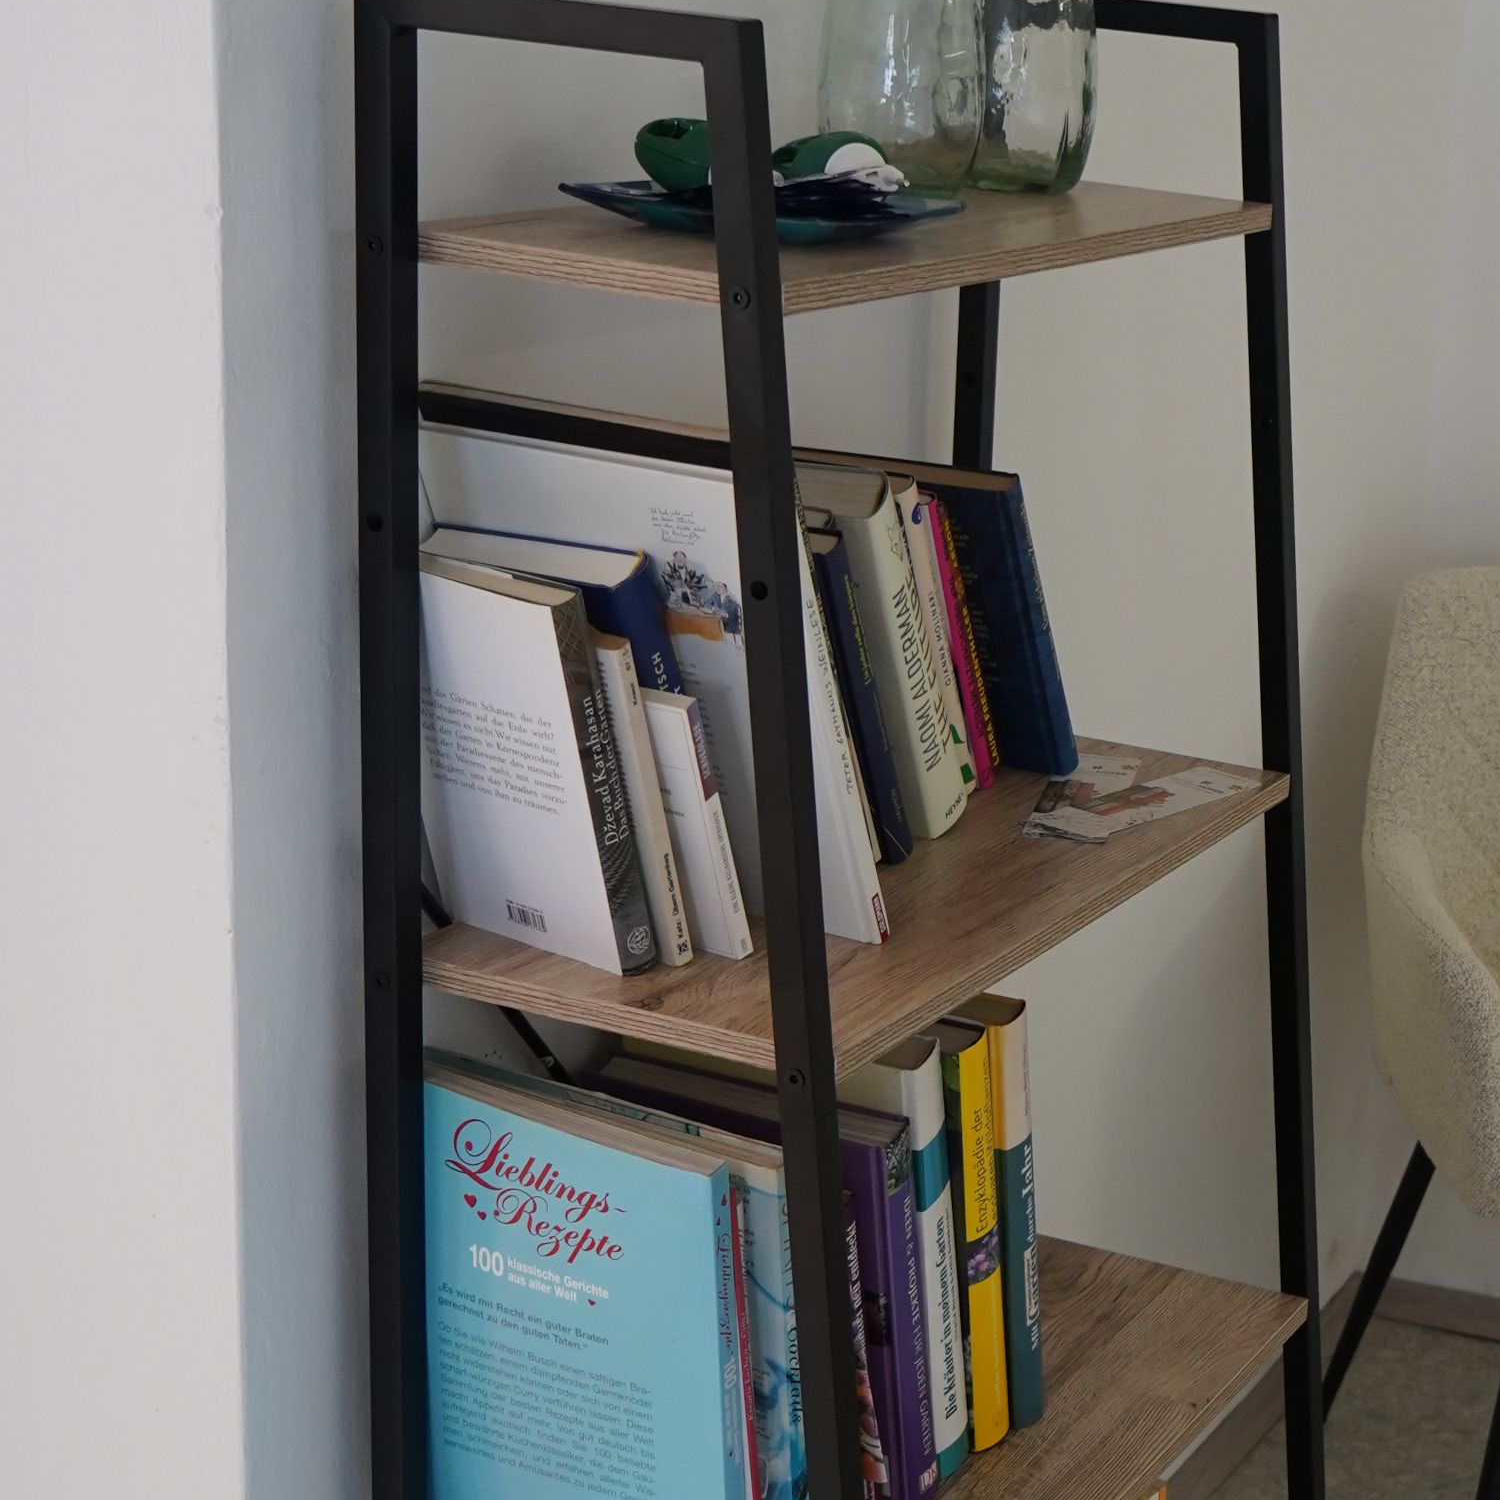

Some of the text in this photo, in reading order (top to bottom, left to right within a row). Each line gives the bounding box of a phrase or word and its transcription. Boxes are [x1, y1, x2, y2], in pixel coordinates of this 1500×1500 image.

[926, 590, 953, 687] GIANNA MOLINARI
[960, 602, 992, 722] FREUDENTHALER
[891, 582, 943, 773] NAOMI ALDERMAN
[580, 696, 621, 846] Dževad Karahasan
[983, 722, 1001, 767] LAURA
[445, 1118, 628, 1224] Lieblings-
[970, 1106, 990, 1233] Enzyklopädie der
[1019, 1144, 1034, 1197] Jahr
[493, 1187, 625, 1264] Rezepte
[902, 1194, 915, 1240] IDEEN
[933, 1216, 950, 1268] Garten
[468, 1241, 504, 1279] 100
[845, 1219, 861, 1281] entdeckt
[905, 1243, 916, 1255] &
[506, 1255, 609, 1300] klassische Gerichte
[507, 1272, 577, 1303] aus aller Welt
[852, 1284, 863, 1308] neu
[905, 1259, 921, 1325] PROJEKTE
[935, 1269, 953, 1323] meinem
[437, 1294, 550, 1343] gerechnet zu den guten
[455, 1287, 609, 1347] wird mit Recht ein guter Braten
[939, 1323, 954, 1338] in
[462, 1355, 517, 1381] widerstehen
[519, 1373, 554, 1393] können
[557, 1384, 578, 1400] oder
[602, 1400, 621, 1413] von
[527, 1350, 557, 1369] Busch
[559, 1361, 585, 1377] einen
[629, 1381, 651, 1397] Bra-
[724, 1356, 737, 1390] 100
[913, 1356, 929, 1399] JEDEN
[939, 1339, 958, 1395] Kräuter
[441, 1385, 469, 1405] macht
[556, 1422, 575, 1437] Von
[578, 1429, 594, 1444] gut
[597, 1435, 637, 1456] deutsch
[510, 1395, 542, 1415] besten
[632, 1432, 654, 1449] Welt
[918, 1400, 934, 1456] GARTEN
[943, 1393, 959, 1420] Die
[442, 1410, 459, 1426] und
[607, 1462, 629, 1478] dem
[532, 1452, 551, 1467] und
[571, 1439, 587, 1453] Sie
[593, 1445, 611, 1460] 100
[497, 1453, 516, 1467] und
[573, 1477, 585, 1489] zu
